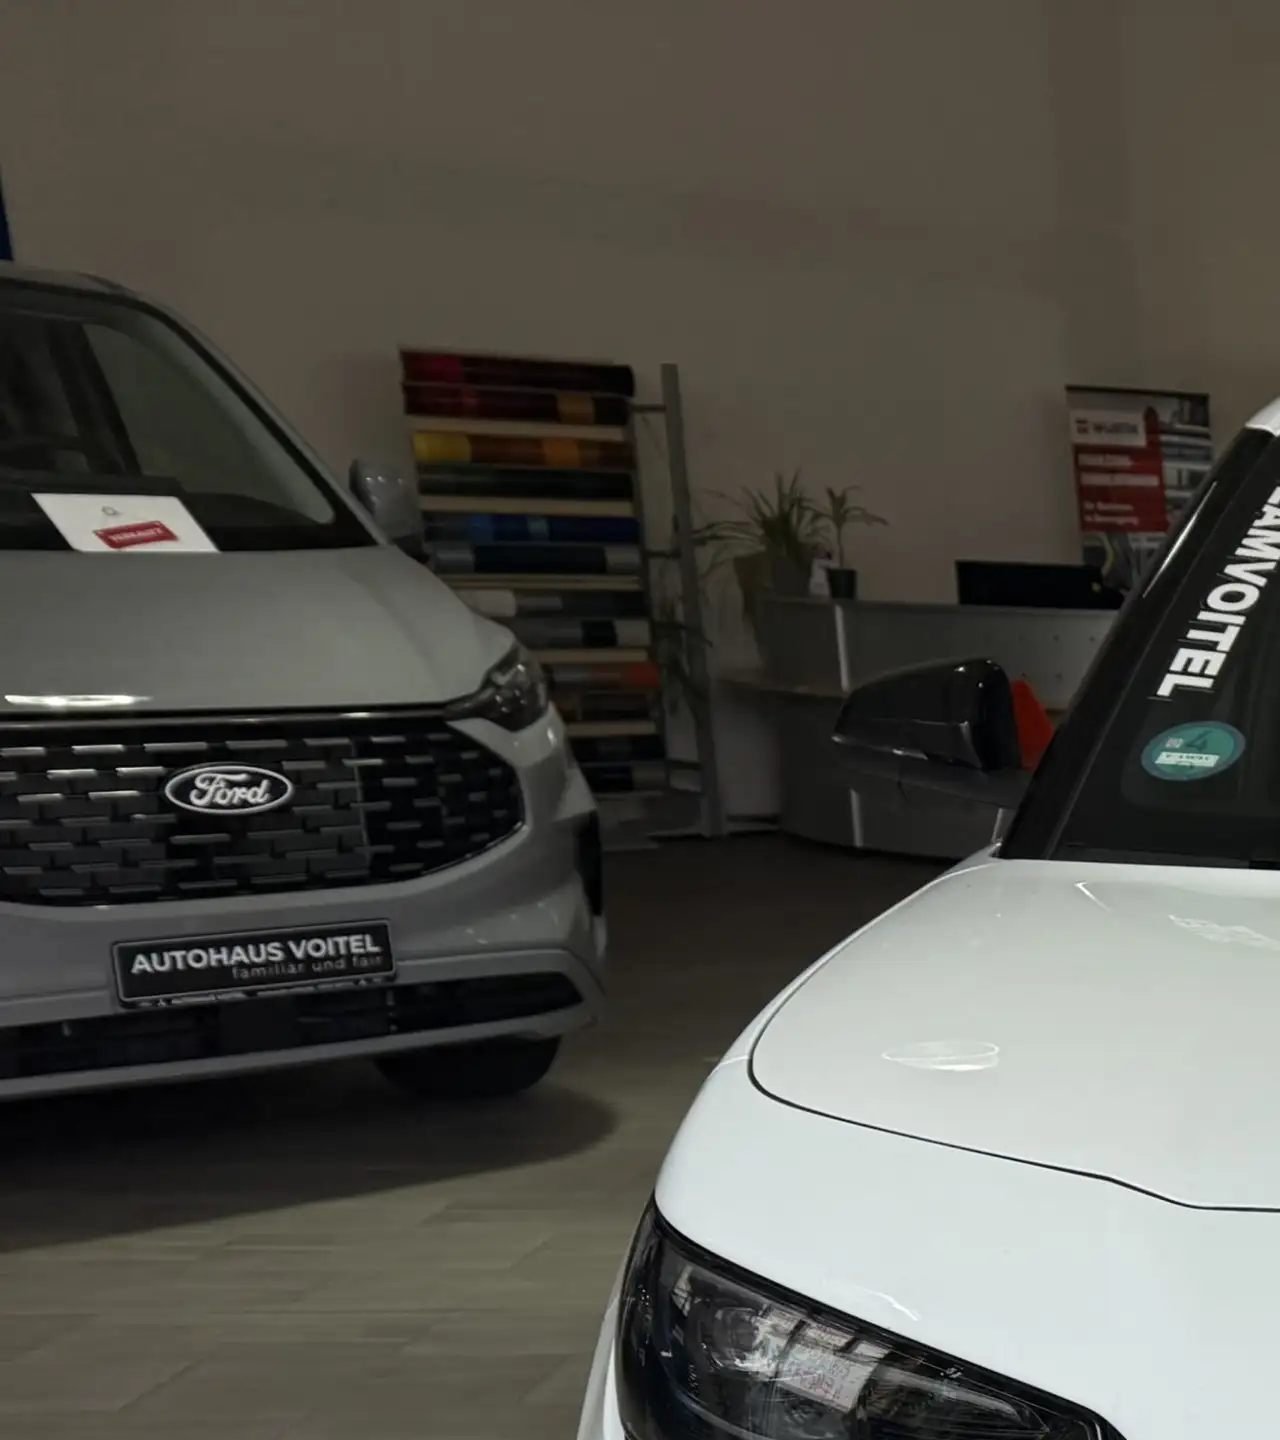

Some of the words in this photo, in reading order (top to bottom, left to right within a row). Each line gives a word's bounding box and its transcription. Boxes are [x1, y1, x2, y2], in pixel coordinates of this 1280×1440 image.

[130, 941, 284, 975] AUTOHAUS
[288, 934, 383, 960] VOITEL
[312, 957, 345, 973] und
